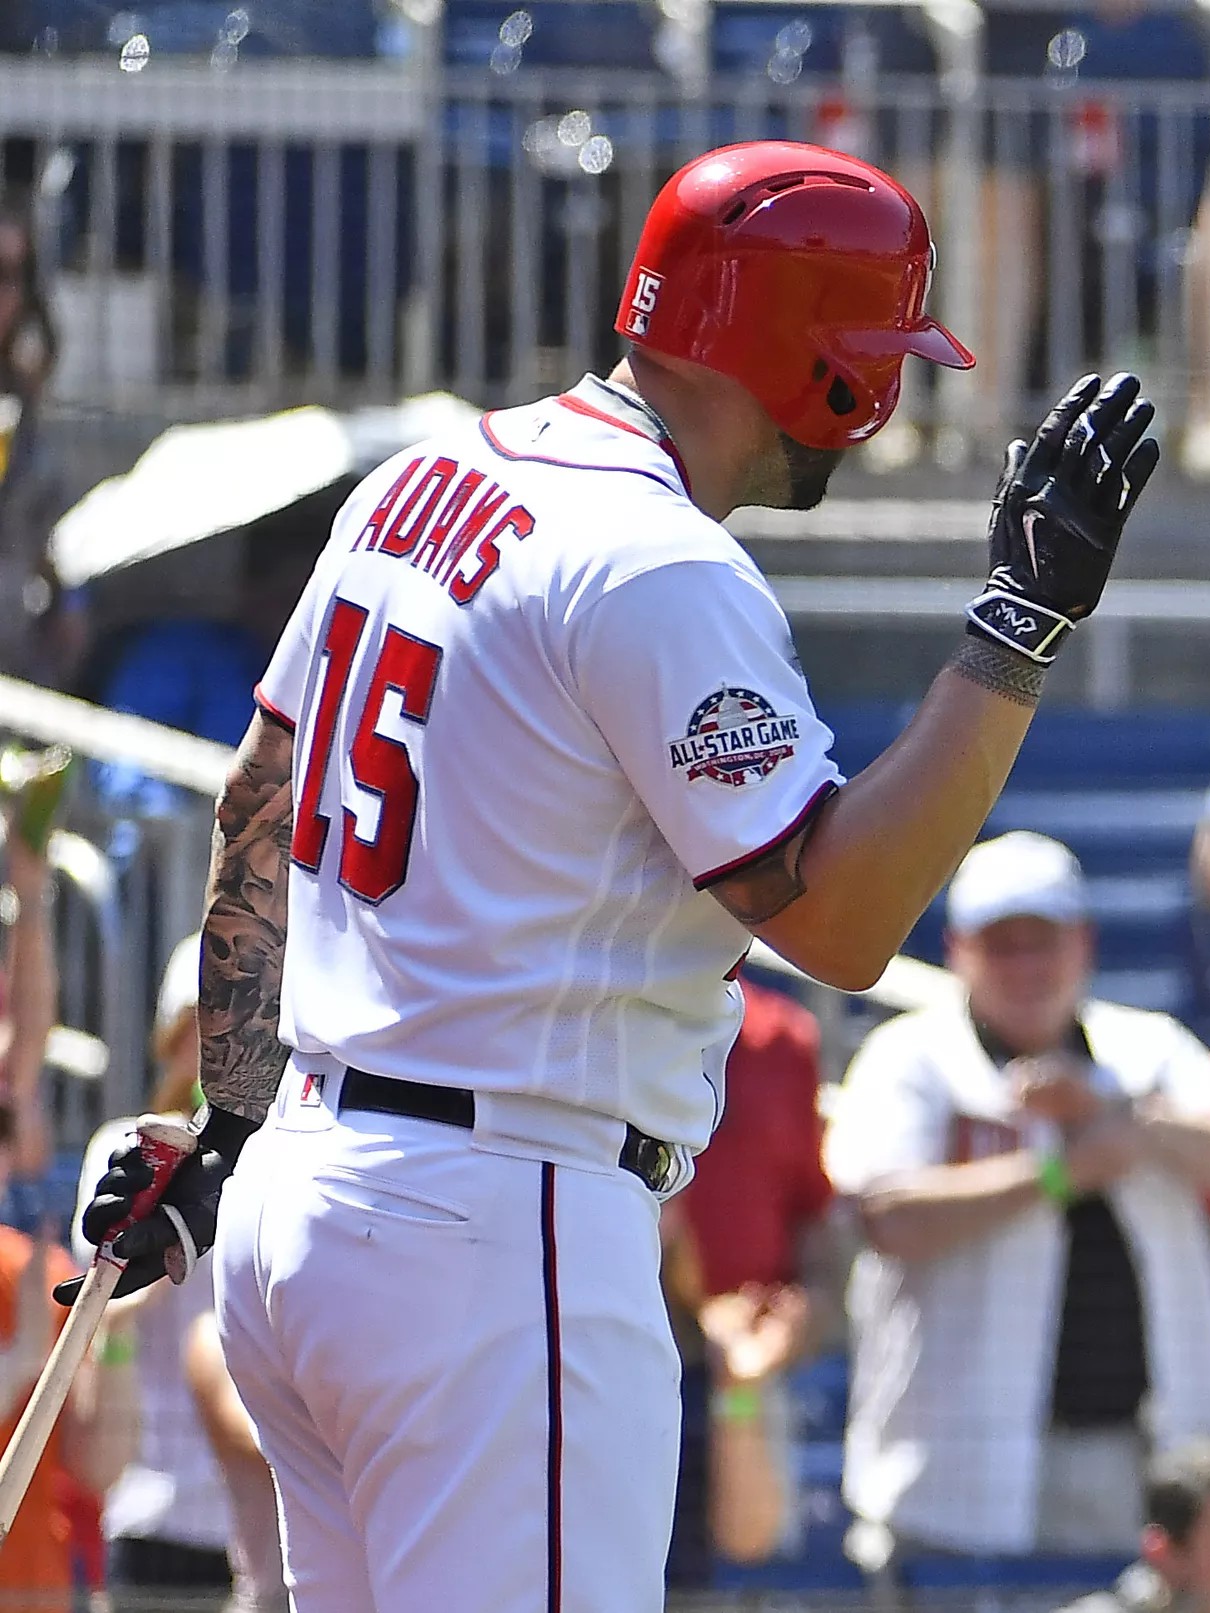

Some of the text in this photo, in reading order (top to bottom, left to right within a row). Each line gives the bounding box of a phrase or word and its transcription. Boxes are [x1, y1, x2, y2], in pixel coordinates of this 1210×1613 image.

[631, 273, 661, 312] 15
[349, 456, 536, 606] ADAMS
[995, 602, 1038, 636] MVP
[290, 595, 444, 907] 15
[757, 719, 800, 745] GAME
